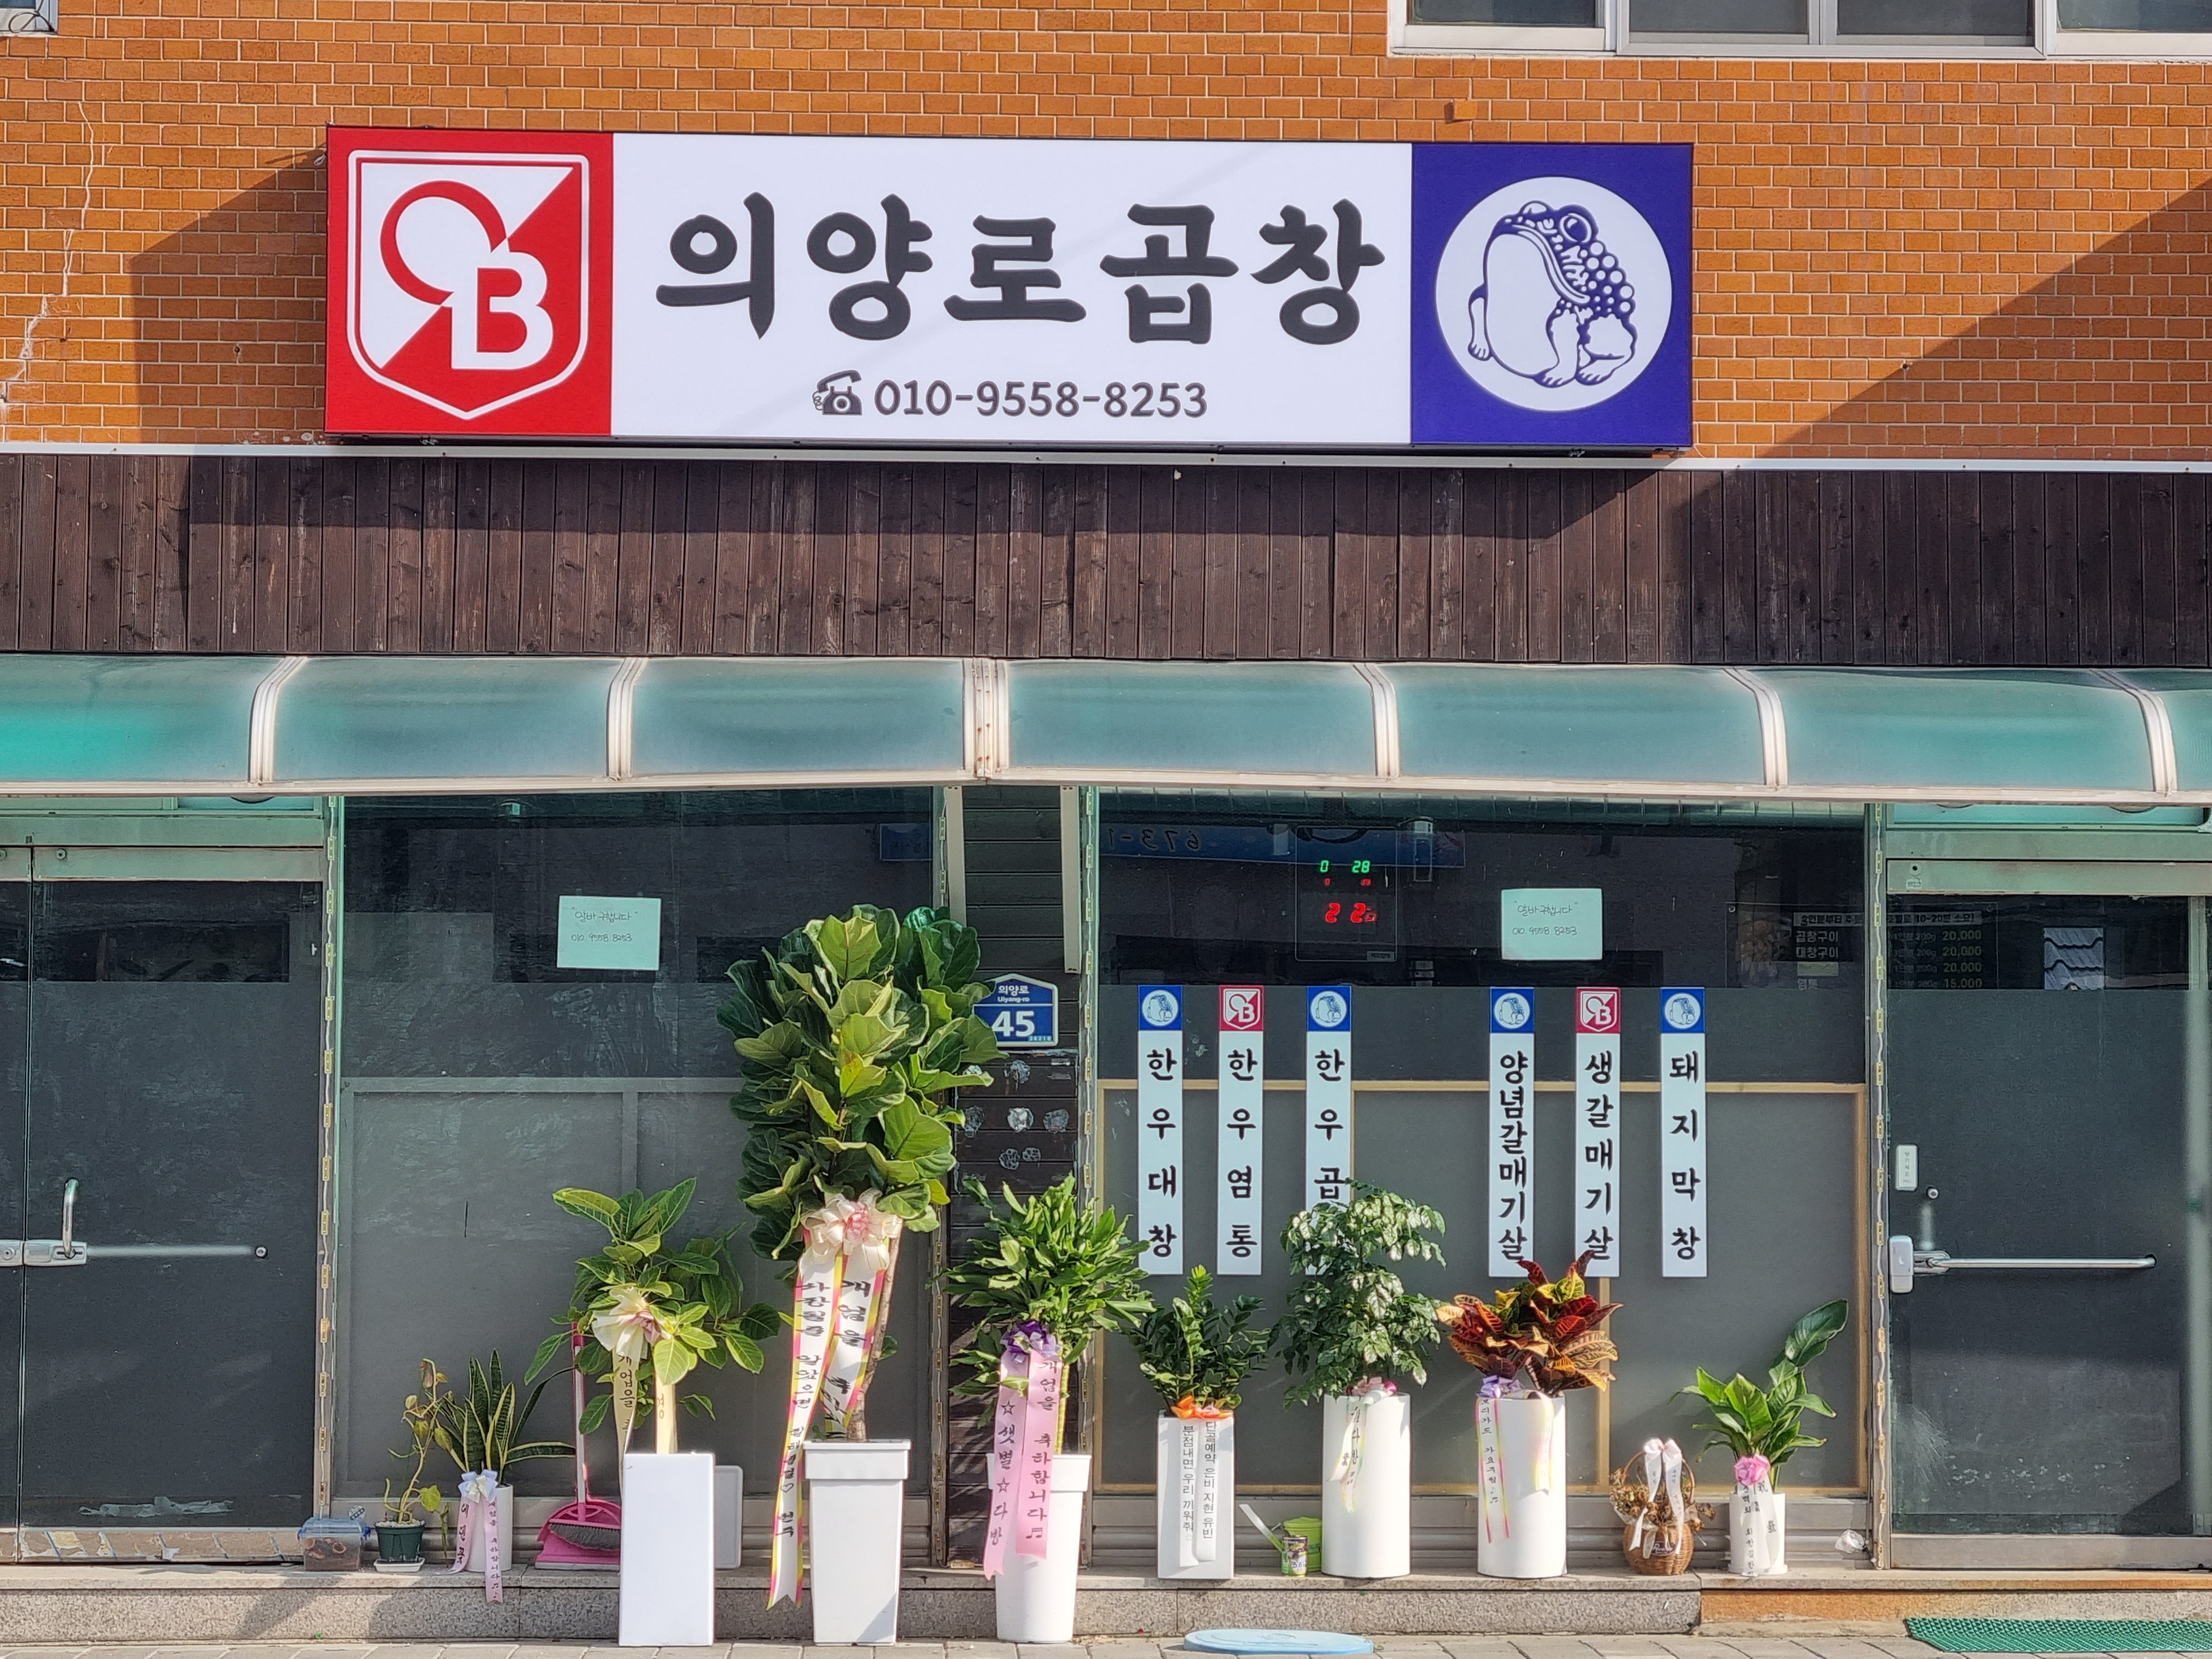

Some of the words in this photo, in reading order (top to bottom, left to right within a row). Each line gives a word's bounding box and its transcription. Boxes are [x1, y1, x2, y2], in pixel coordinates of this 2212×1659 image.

[656, 191, 1385, 345] 의양로곱창
[875, 379, 1207, 417] 010-9558-8253
[1351, 860, 1371, 873] 28
[1795, 930, 1838, 943] 곱창구이
[991, 1011, 1035, 1037] 45
[998, 985, 1030, 996] 의양로
[1146, 1048, 1177, 1258] 한우대창
[1226, 1048, 1258, 1258] 한우염통
[1314, 1048, 1347, 1200] 한우곱
[1498, 1050, 1529, 1261] 양념갈매기살
[1584, 1050, 1614, 1260] 생갈매기살
[1669, 1050, 1701, 1260] 돼지막창
[1036, 1360, 1058, 1412] 개업을
[1027, 1433, 1053, 1522] 축하합니다
[1182, 1473, 1195, 1495] 우리
